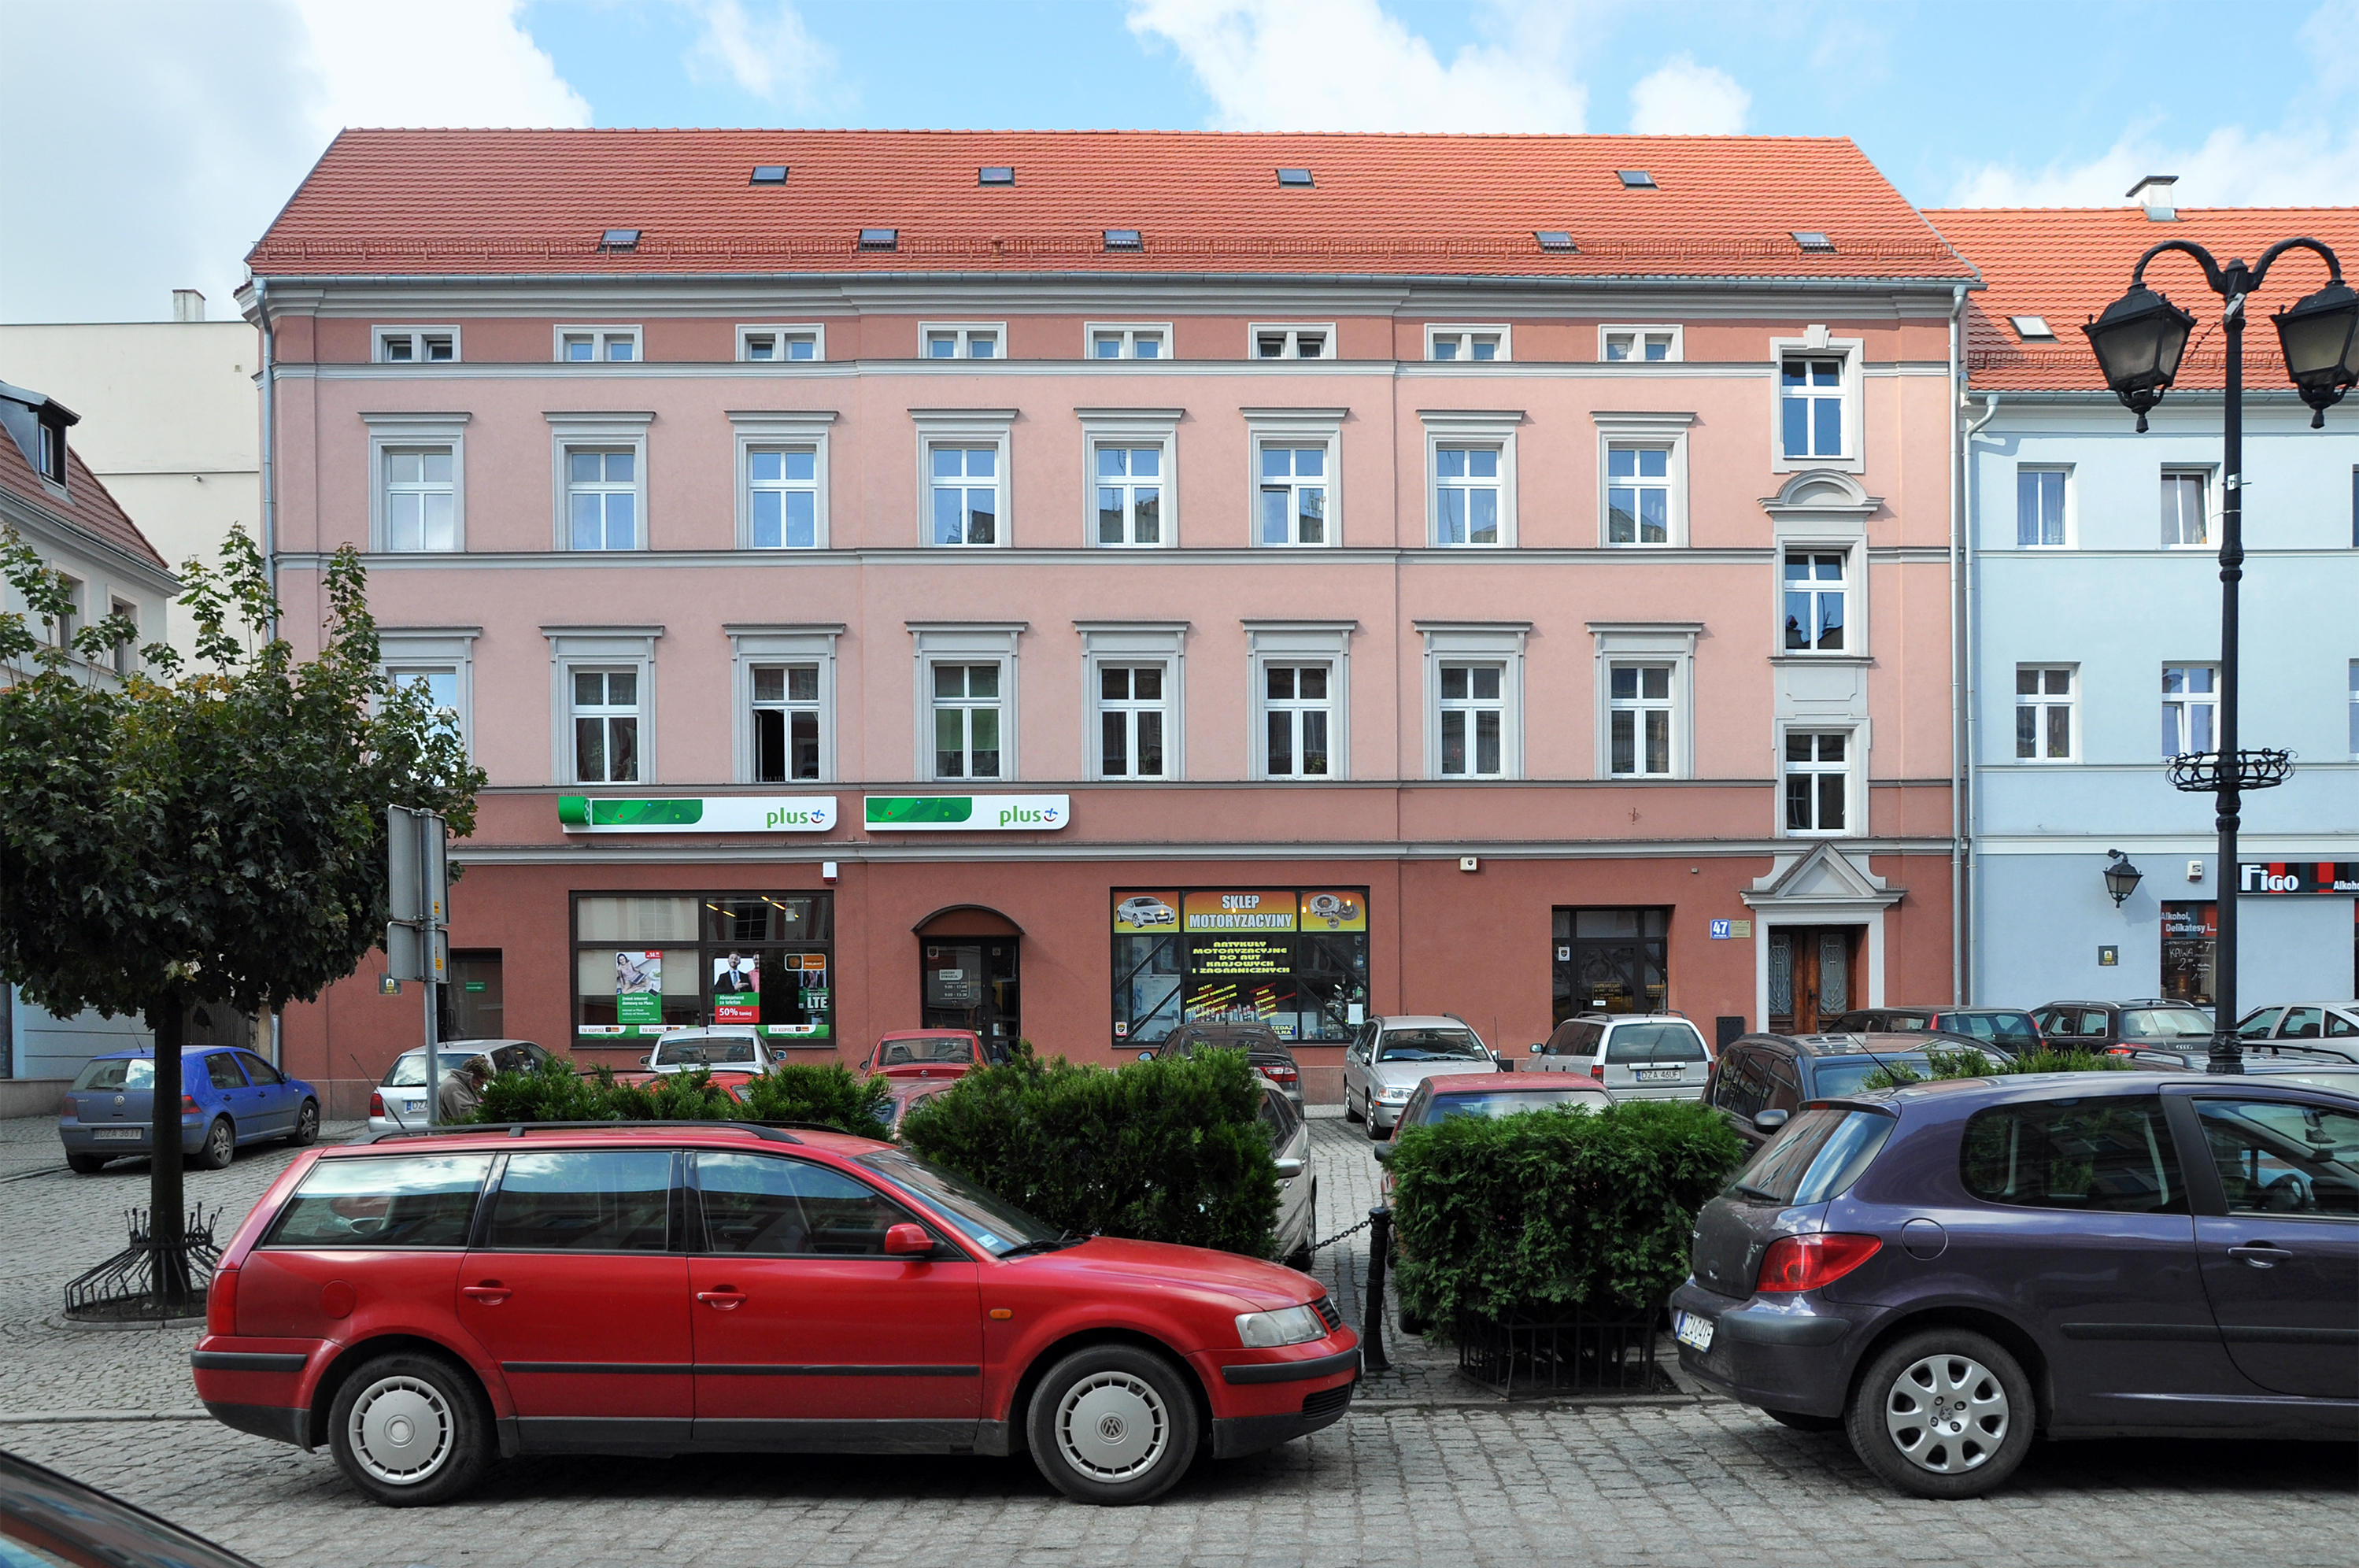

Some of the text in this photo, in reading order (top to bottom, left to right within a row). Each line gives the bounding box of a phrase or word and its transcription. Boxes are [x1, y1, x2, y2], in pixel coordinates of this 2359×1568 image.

[767, 807, 808, 829] plus
[1000, 805, 1041, 827] plus
[1221, 894, 1260, 909] SKLEP
[1189, 913, 1293, 928] MOTORYZACYJNY
[2160, 912, 2191, 922] Alkohol,
[1713, 921, 1728, 934] 47
[2165, 923, 2206, 934] Delikatesy
[807, 997, 827, 1008] LTE
[719, 1008, 738, 1016] 50%
[100, 1128, 116, 1137] DZA
